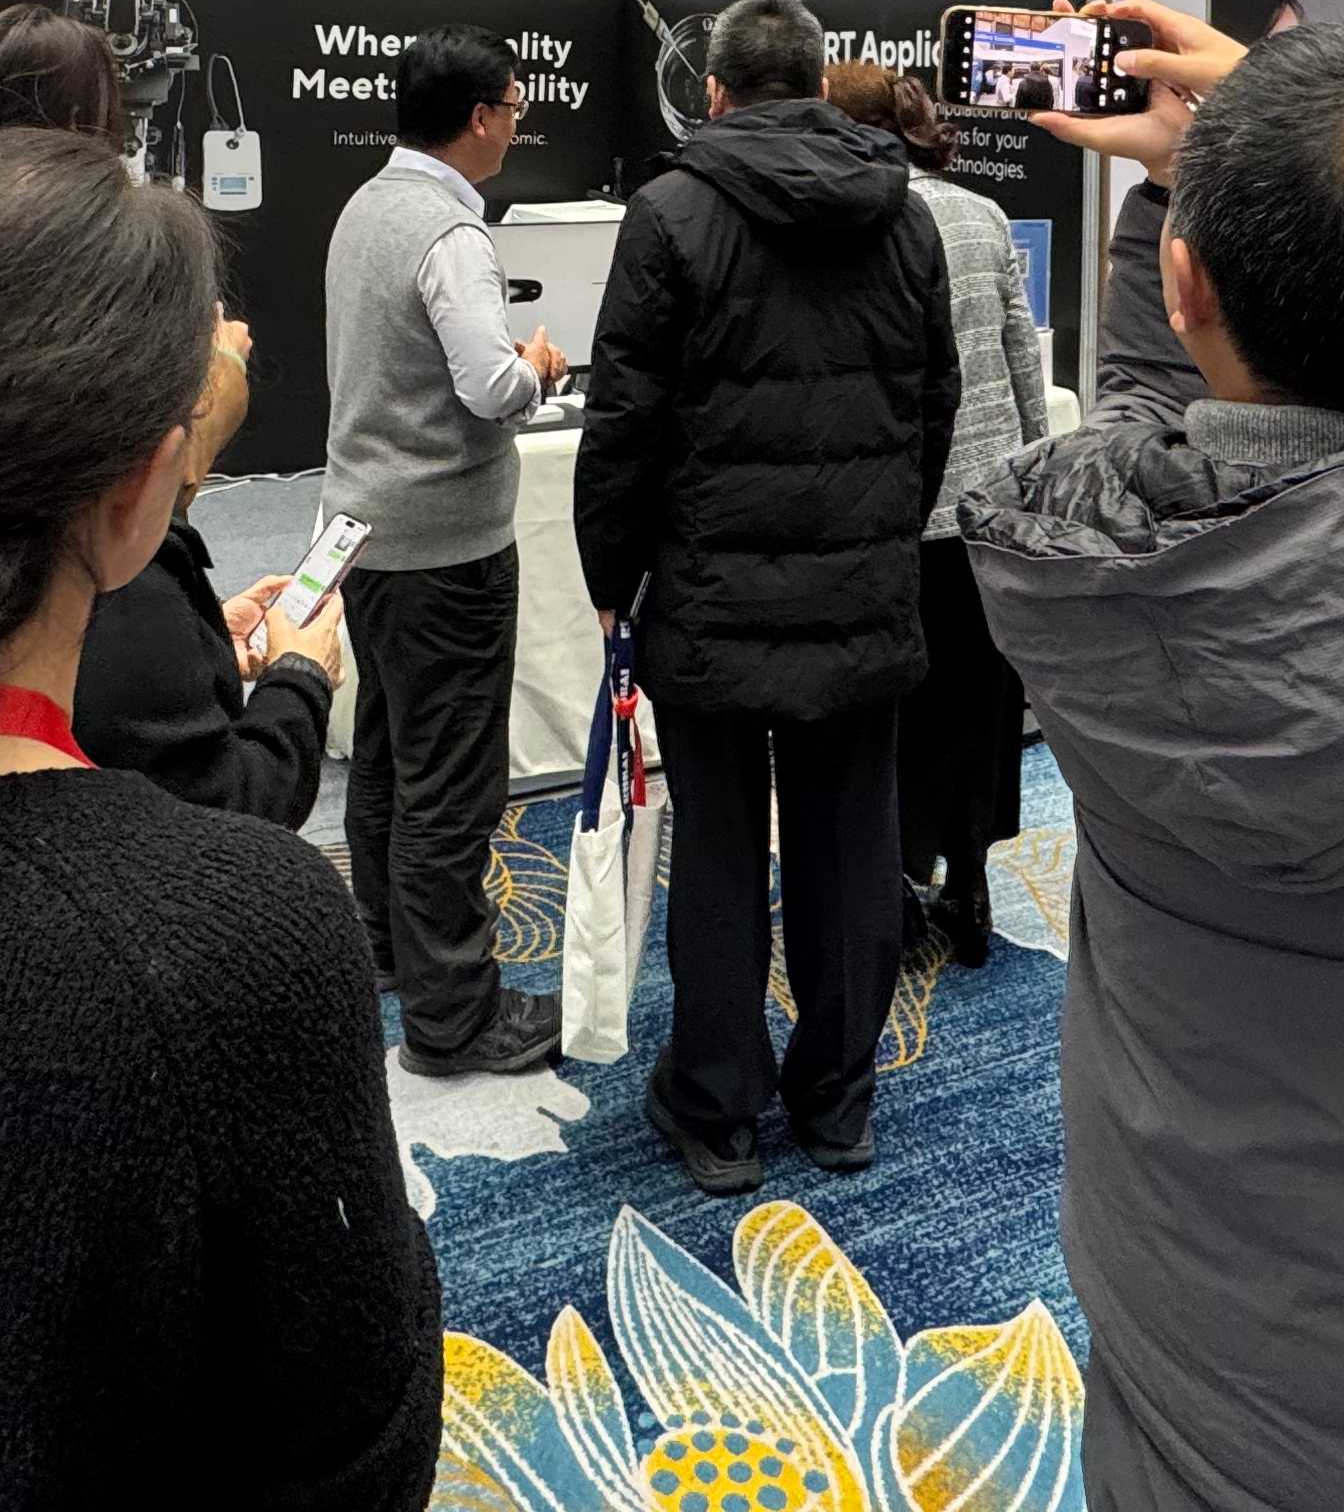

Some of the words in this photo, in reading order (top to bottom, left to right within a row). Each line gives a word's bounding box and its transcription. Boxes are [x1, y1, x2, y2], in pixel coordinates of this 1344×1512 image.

[823, 30, 857, 65] RT
[858, 29, 941, 78] Applic
[332, 130, 398, 146] Intuitive
[509, 132, 549, 146] omic.
[971, 126, 992, 147] for
[995, 133, 1029, 153] your
[949, 152, 1028, 182] chnologies.
